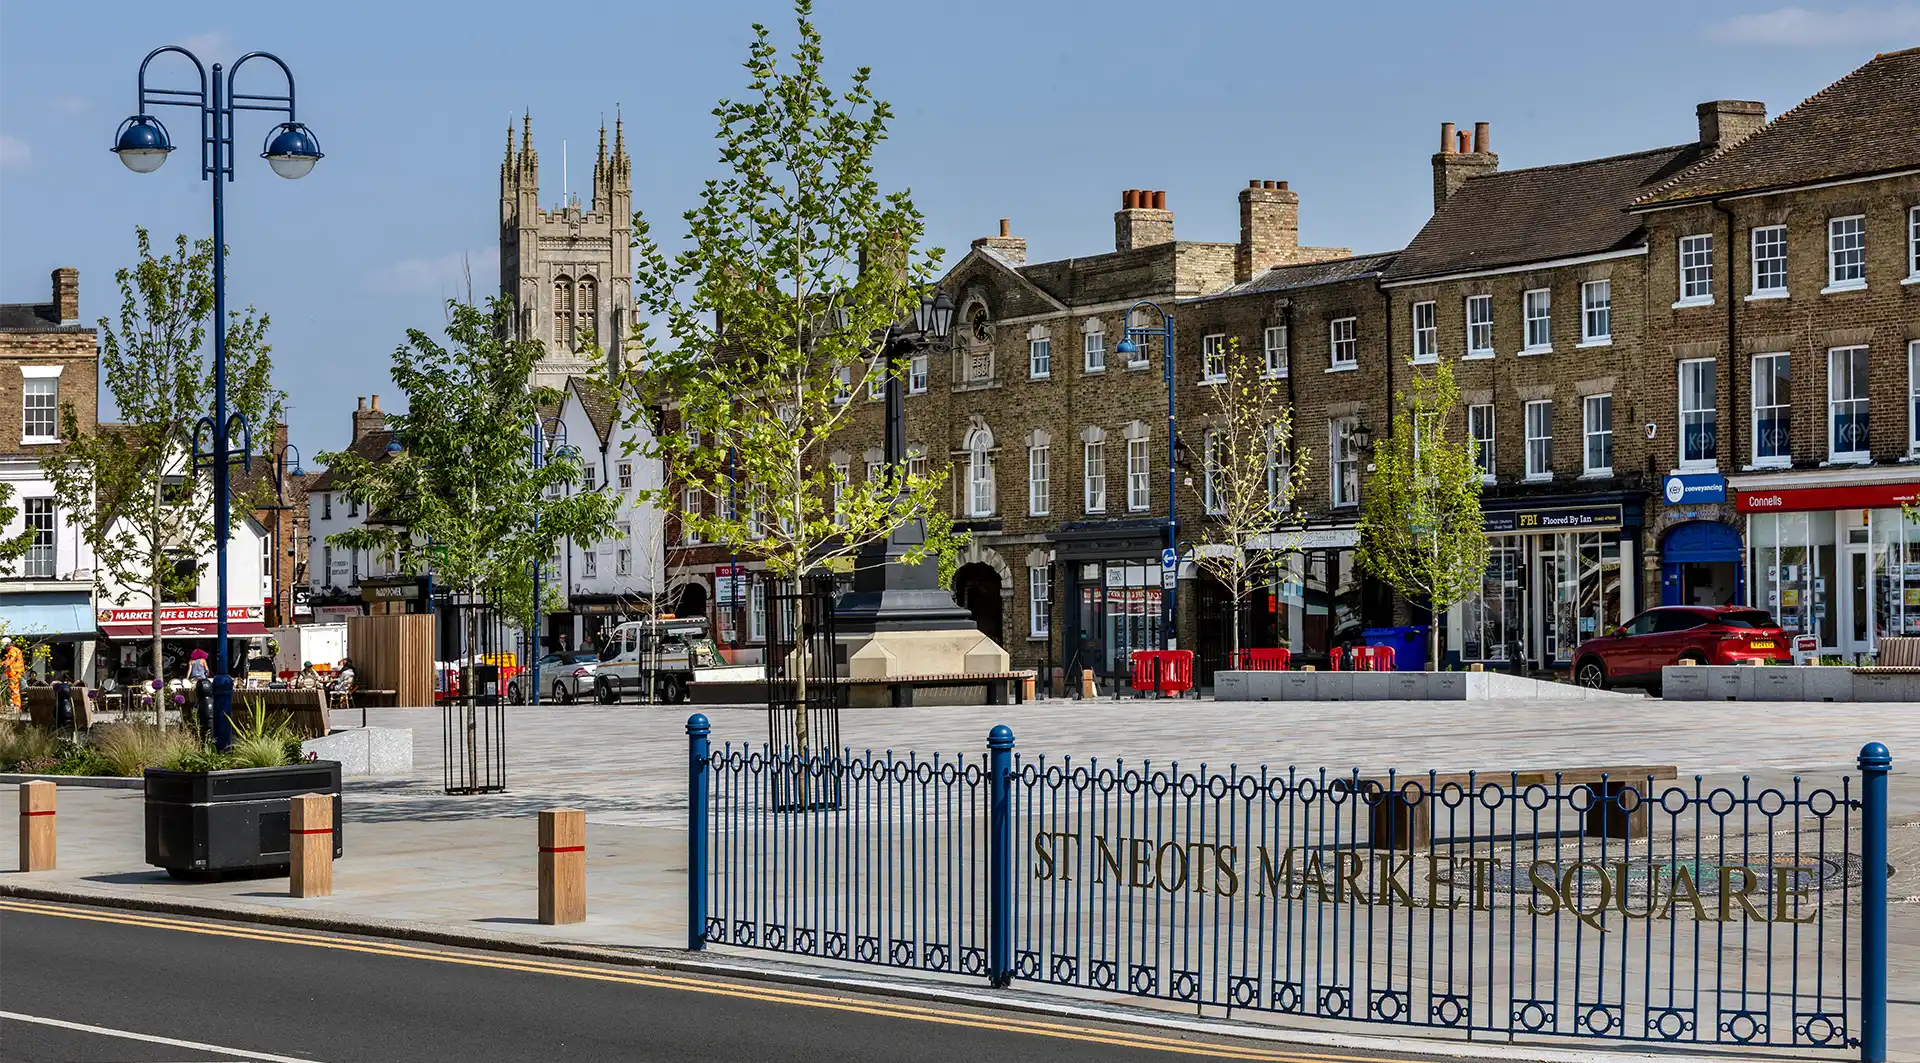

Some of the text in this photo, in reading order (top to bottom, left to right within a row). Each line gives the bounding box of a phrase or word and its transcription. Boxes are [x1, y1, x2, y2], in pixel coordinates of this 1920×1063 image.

[1685, 484, 1722, 492] conveyancing
[1749, 496, 1783, 507] Connells
[1520, 514, 1538, 526] FBI
[1542, 516, 1569, 525] Floored
[1569, 515, 1579, 526] By
[1580, 514, 1592, 523] Ian
[115, 608, 244, 620] MARKET AFE & RESTAUANT
[167, 643, 185, 656] Cafe
[1034, 831, 1818, 933] ST NEOTS MARKET SQUARE
